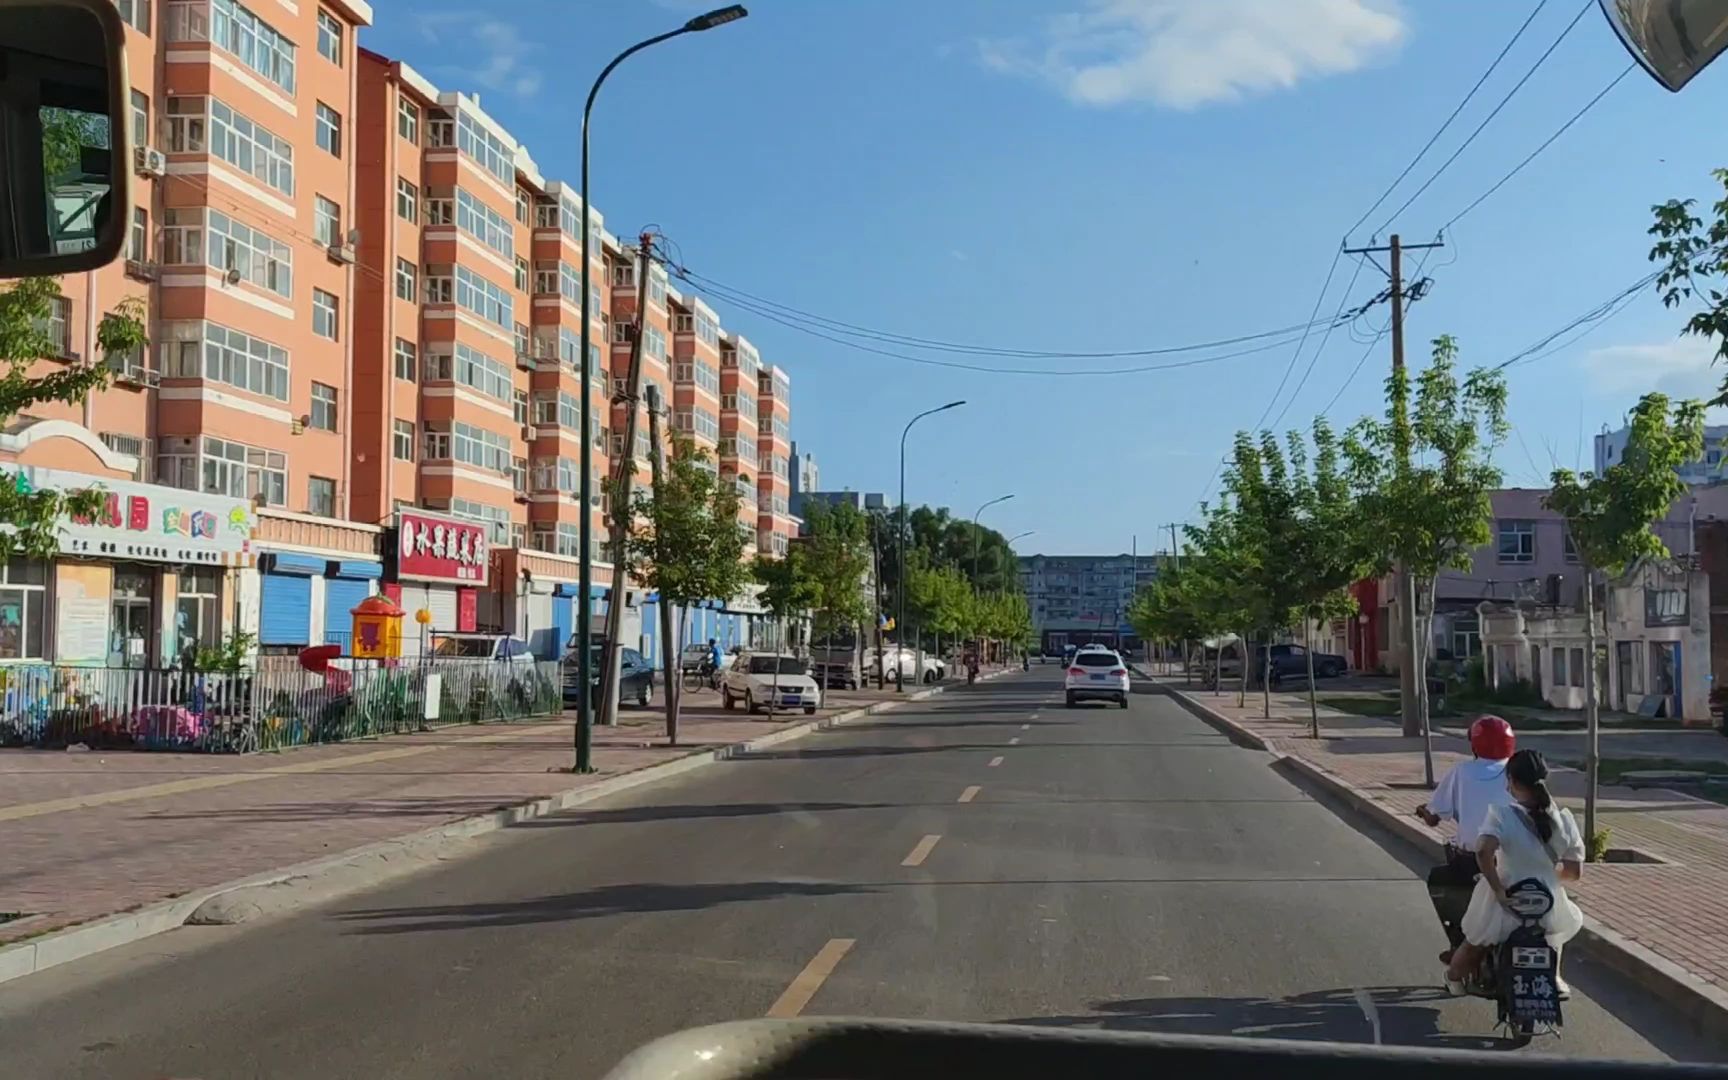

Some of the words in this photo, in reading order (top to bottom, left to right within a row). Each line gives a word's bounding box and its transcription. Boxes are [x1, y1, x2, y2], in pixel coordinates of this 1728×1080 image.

[416, 521, 483, 565] 水果蔬菜店
